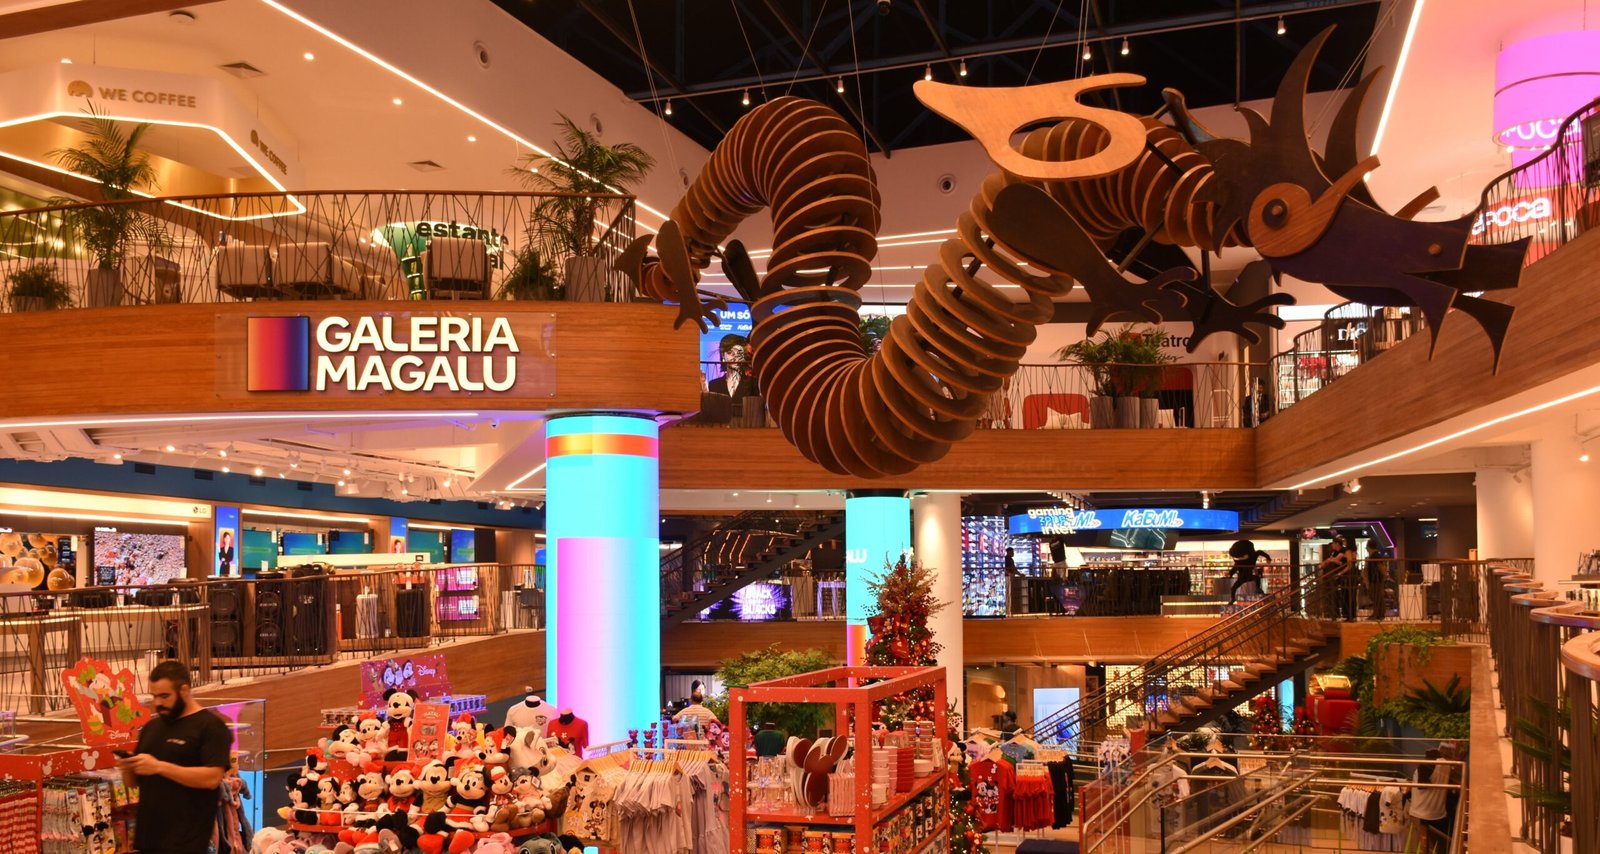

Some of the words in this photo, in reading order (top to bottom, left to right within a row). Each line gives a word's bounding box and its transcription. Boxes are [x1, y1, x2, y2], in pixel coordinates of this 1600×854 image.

[98, 86, 127, 102] WE
[132, 90, 196, 108] COFFEE
[260, 140, 269, 158] WE
[268, 149, 287, 176] COFFEE
[720, 311, 736, 320] UM
[737, 310, 751, 320] SÓ
[316, 316, 519, 353] GALERIA
[1142, 334, 1191, 348] Tatro
[316, 355, 516, 391] MAGALU
[1028, 506, 1074, 521] gaming
[1121, 510, 1178, 528] KaBuM!
[416, 664, 436, 678] Disney
[107, 729, 130, 740] Disney
